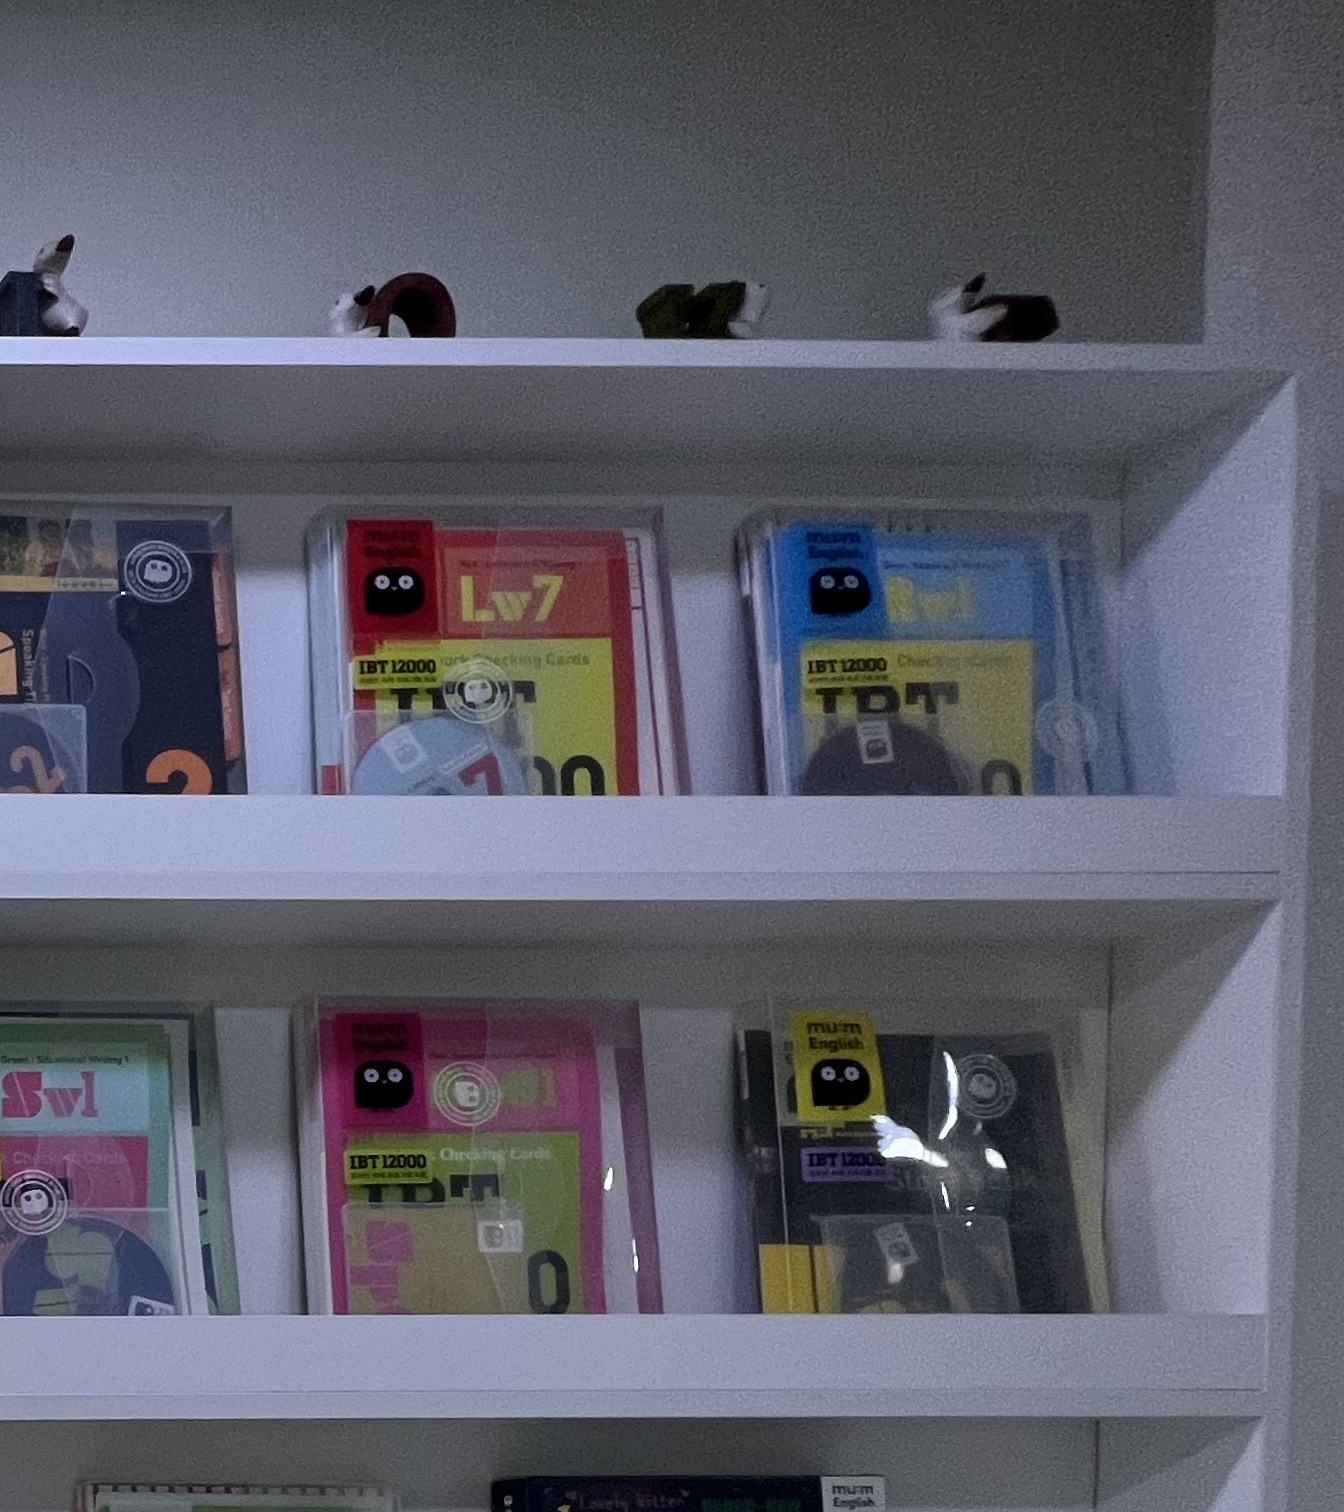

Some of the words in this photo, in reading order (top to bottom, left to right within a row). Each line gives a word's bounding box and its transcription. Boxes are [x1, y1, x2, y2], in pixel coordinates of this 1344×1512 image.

[359, 660, 389, 675] IBT
[391, 659, 437, 674] 12000
[807, 659, 838, 674] IBT
[841, 657, 888, 673] 12000
[808, 1036, 865, 1052] English
[349, 1154, 379, 1169] IBT
[382, 1154, 427, 1169] 12000
[833, 1497, 876, 1510] English
